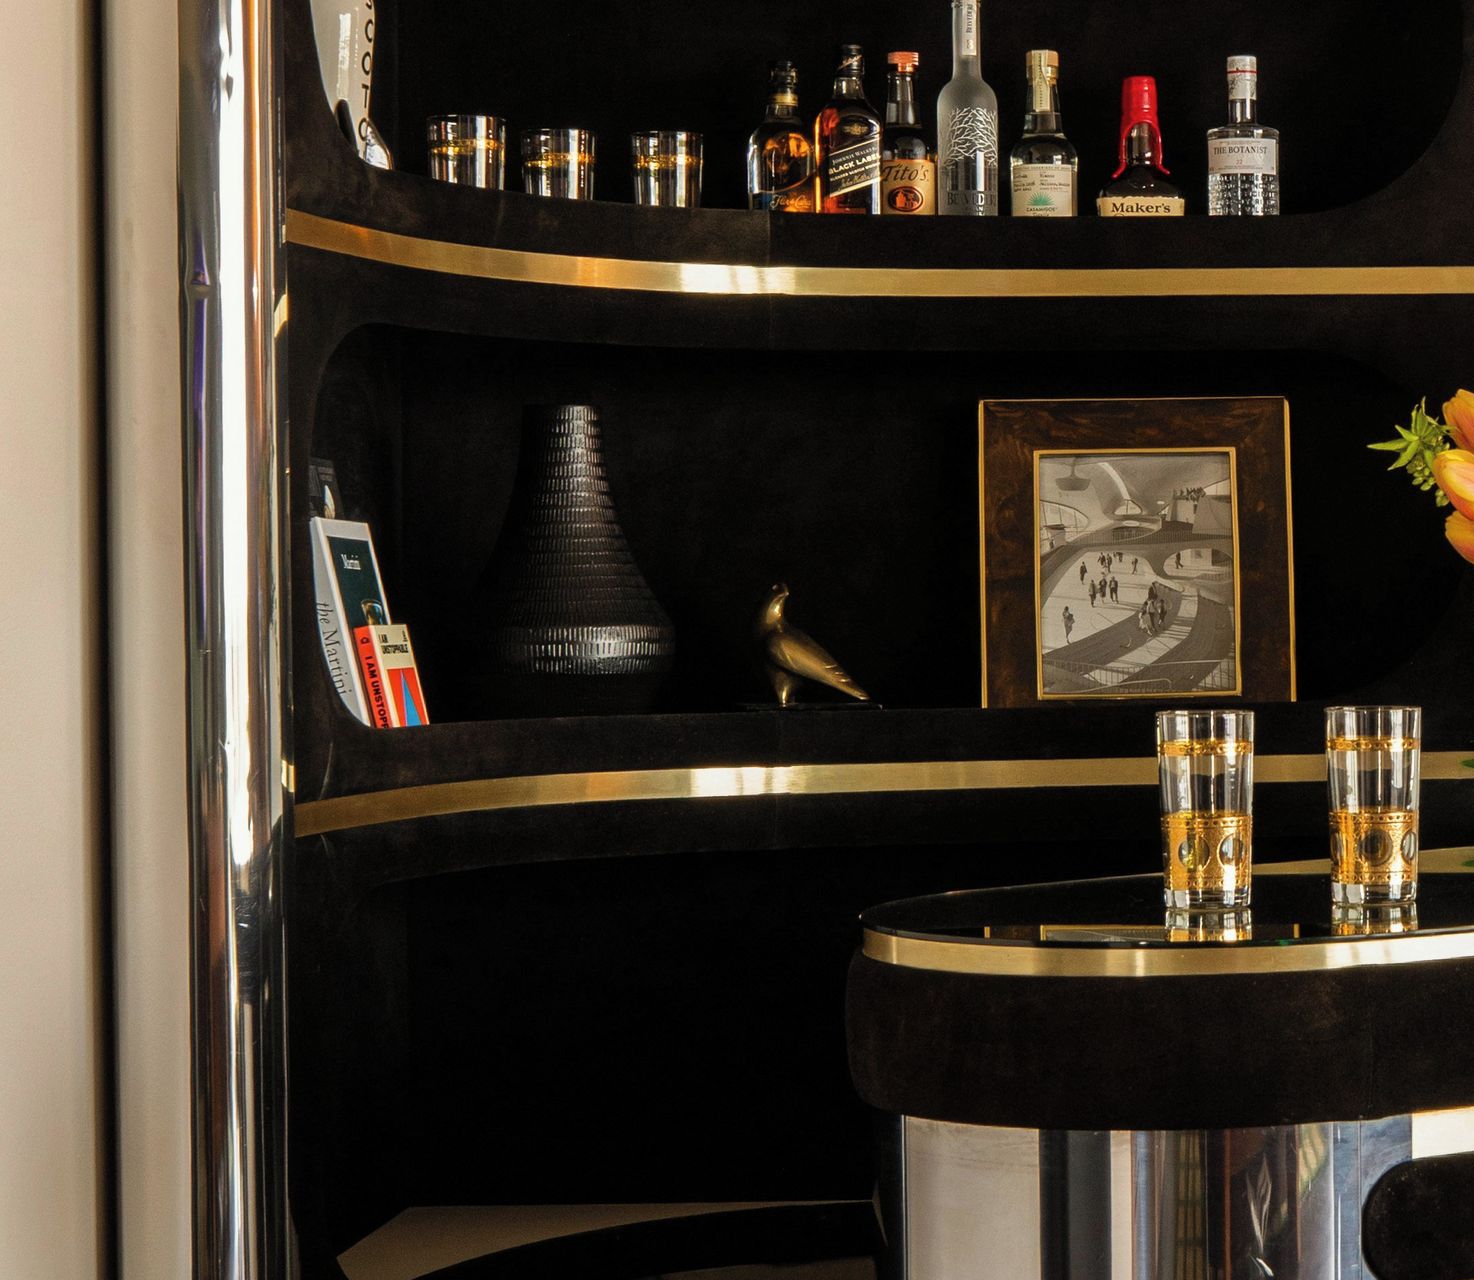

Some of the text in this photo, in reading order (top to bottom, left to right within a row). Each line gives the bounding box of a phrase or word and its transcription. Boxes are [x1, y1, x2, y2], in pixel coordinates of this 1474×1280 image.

[1228, 145, 1268, 155] BOTANIST
[828, 160, 855, 175] BLACK
[882, 163, 930, 183] Tito's
[1111, 202, 1171, 214] Maker's
[322, 628, 353, 696] Martini
[366, 661, 377, 679] AM
